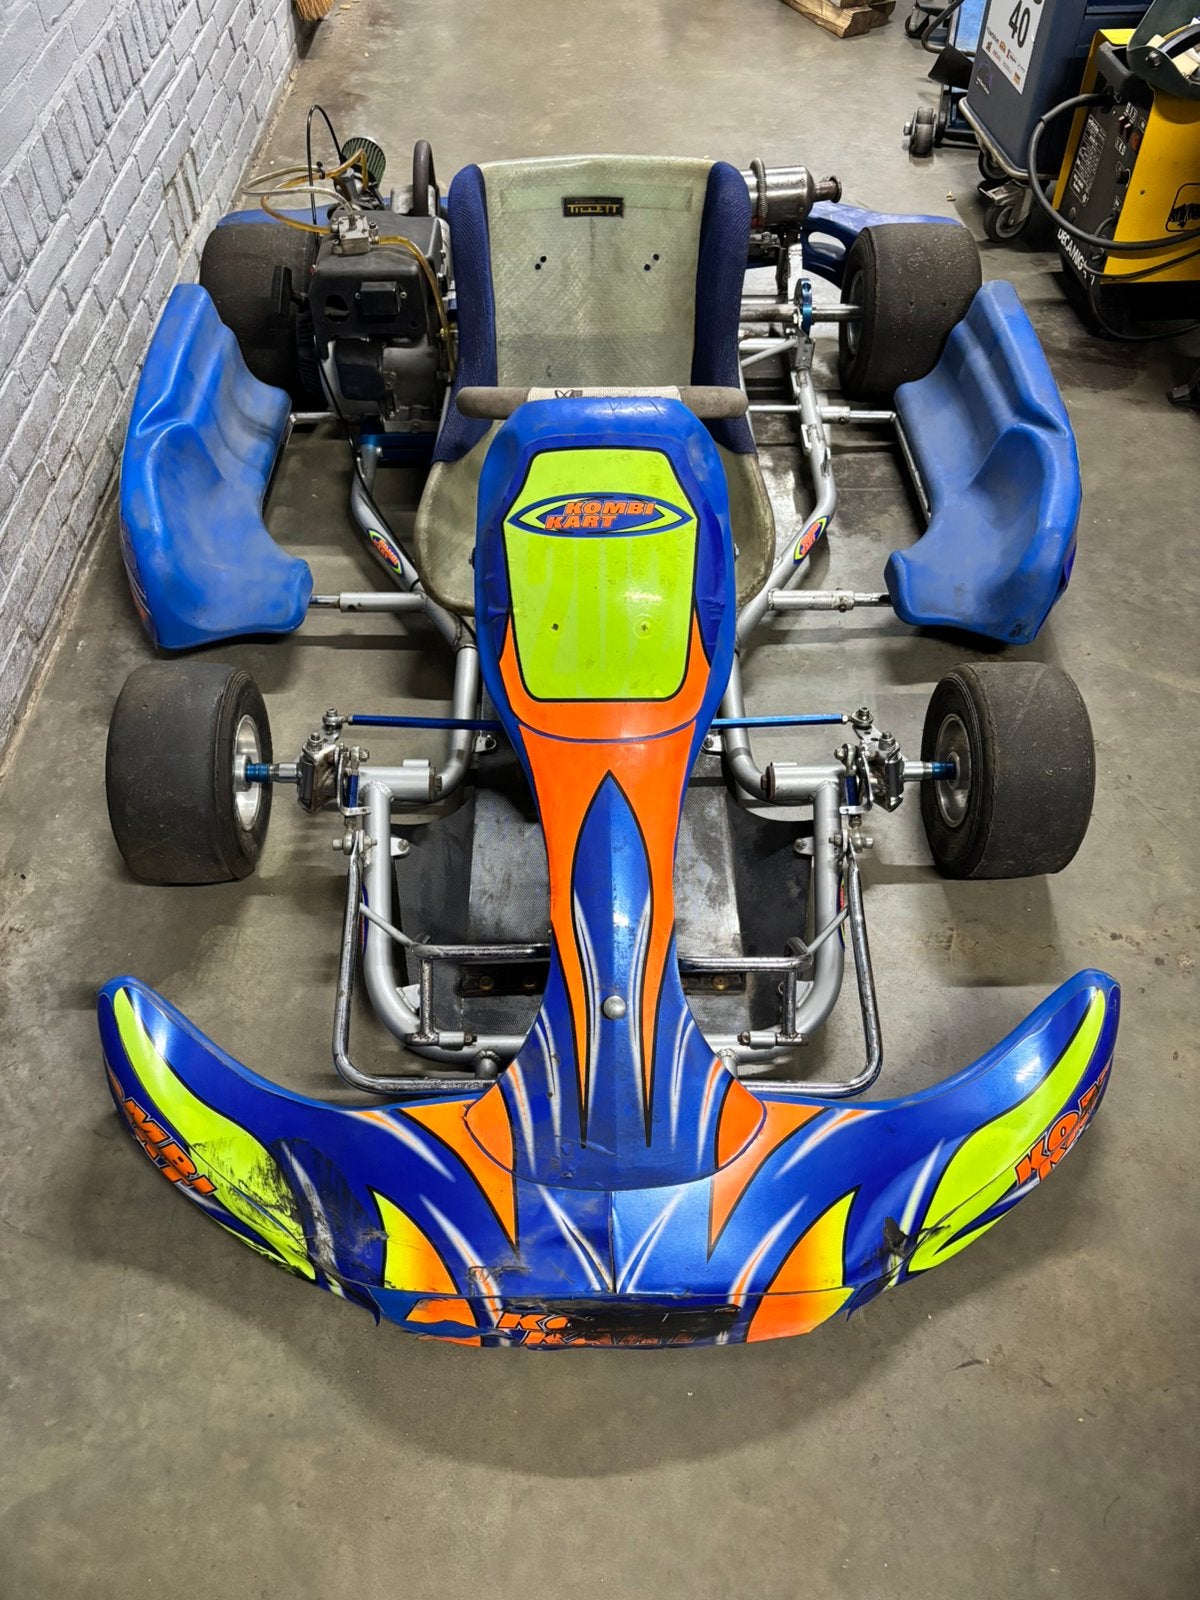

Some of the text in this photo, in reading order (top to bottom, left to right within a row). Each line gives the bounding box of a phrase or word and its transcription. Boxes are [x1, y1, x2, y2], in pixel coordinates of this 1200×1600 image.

[1008, 0, 1031, 48] 40
[564, 501, 655, 515] KOMBI
[545, 515, 616, 529] KART
